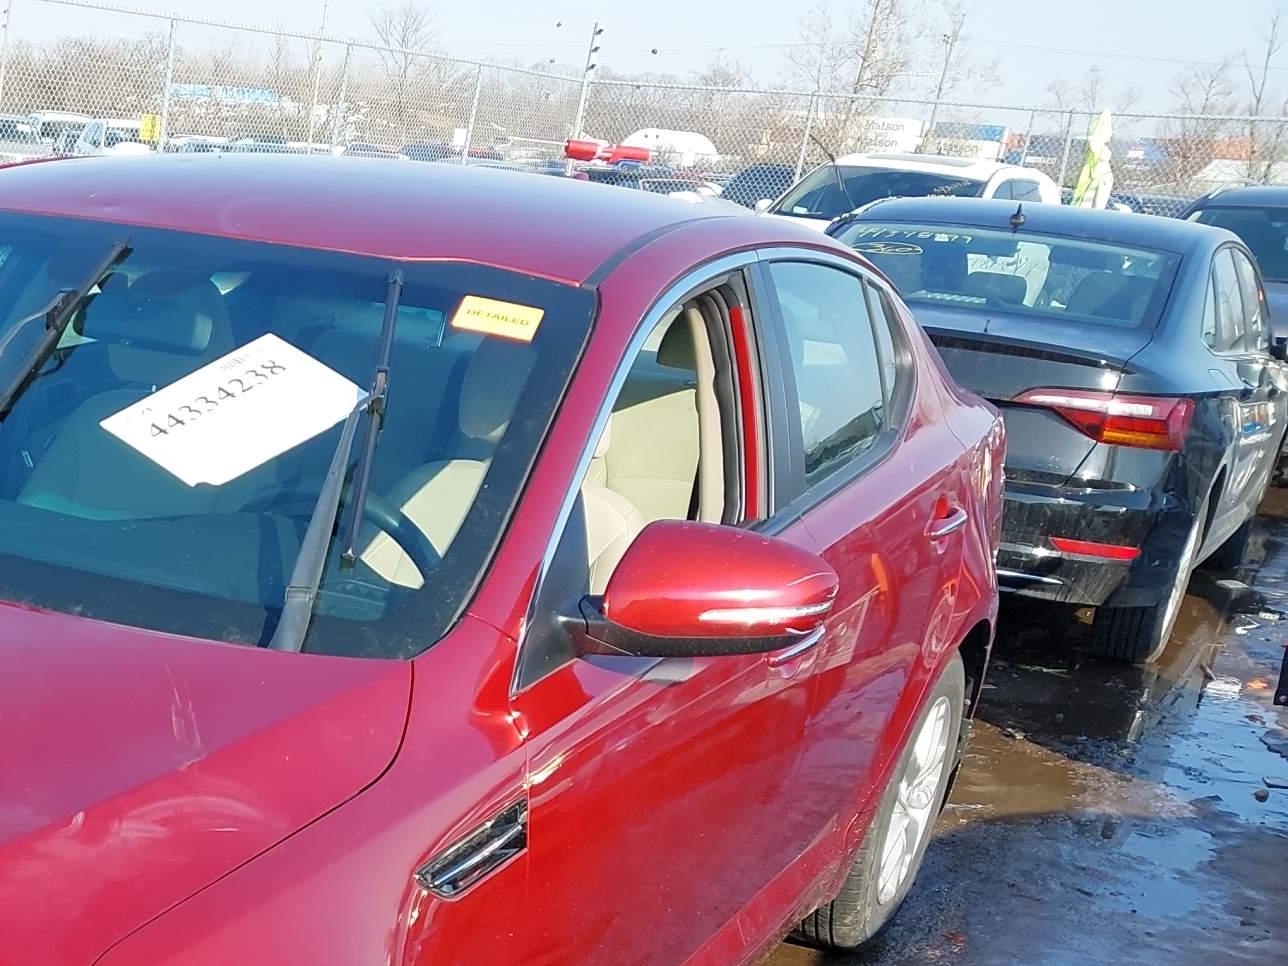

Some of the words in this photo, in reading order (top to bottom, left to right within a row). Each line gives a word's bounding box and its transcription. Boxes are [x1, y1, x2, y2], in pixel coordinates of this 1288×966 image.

[864, 119, 904, 132] Matson
[466, 308, 531, 326] DETAILED
[150, 359, 287, 437] 44334238
